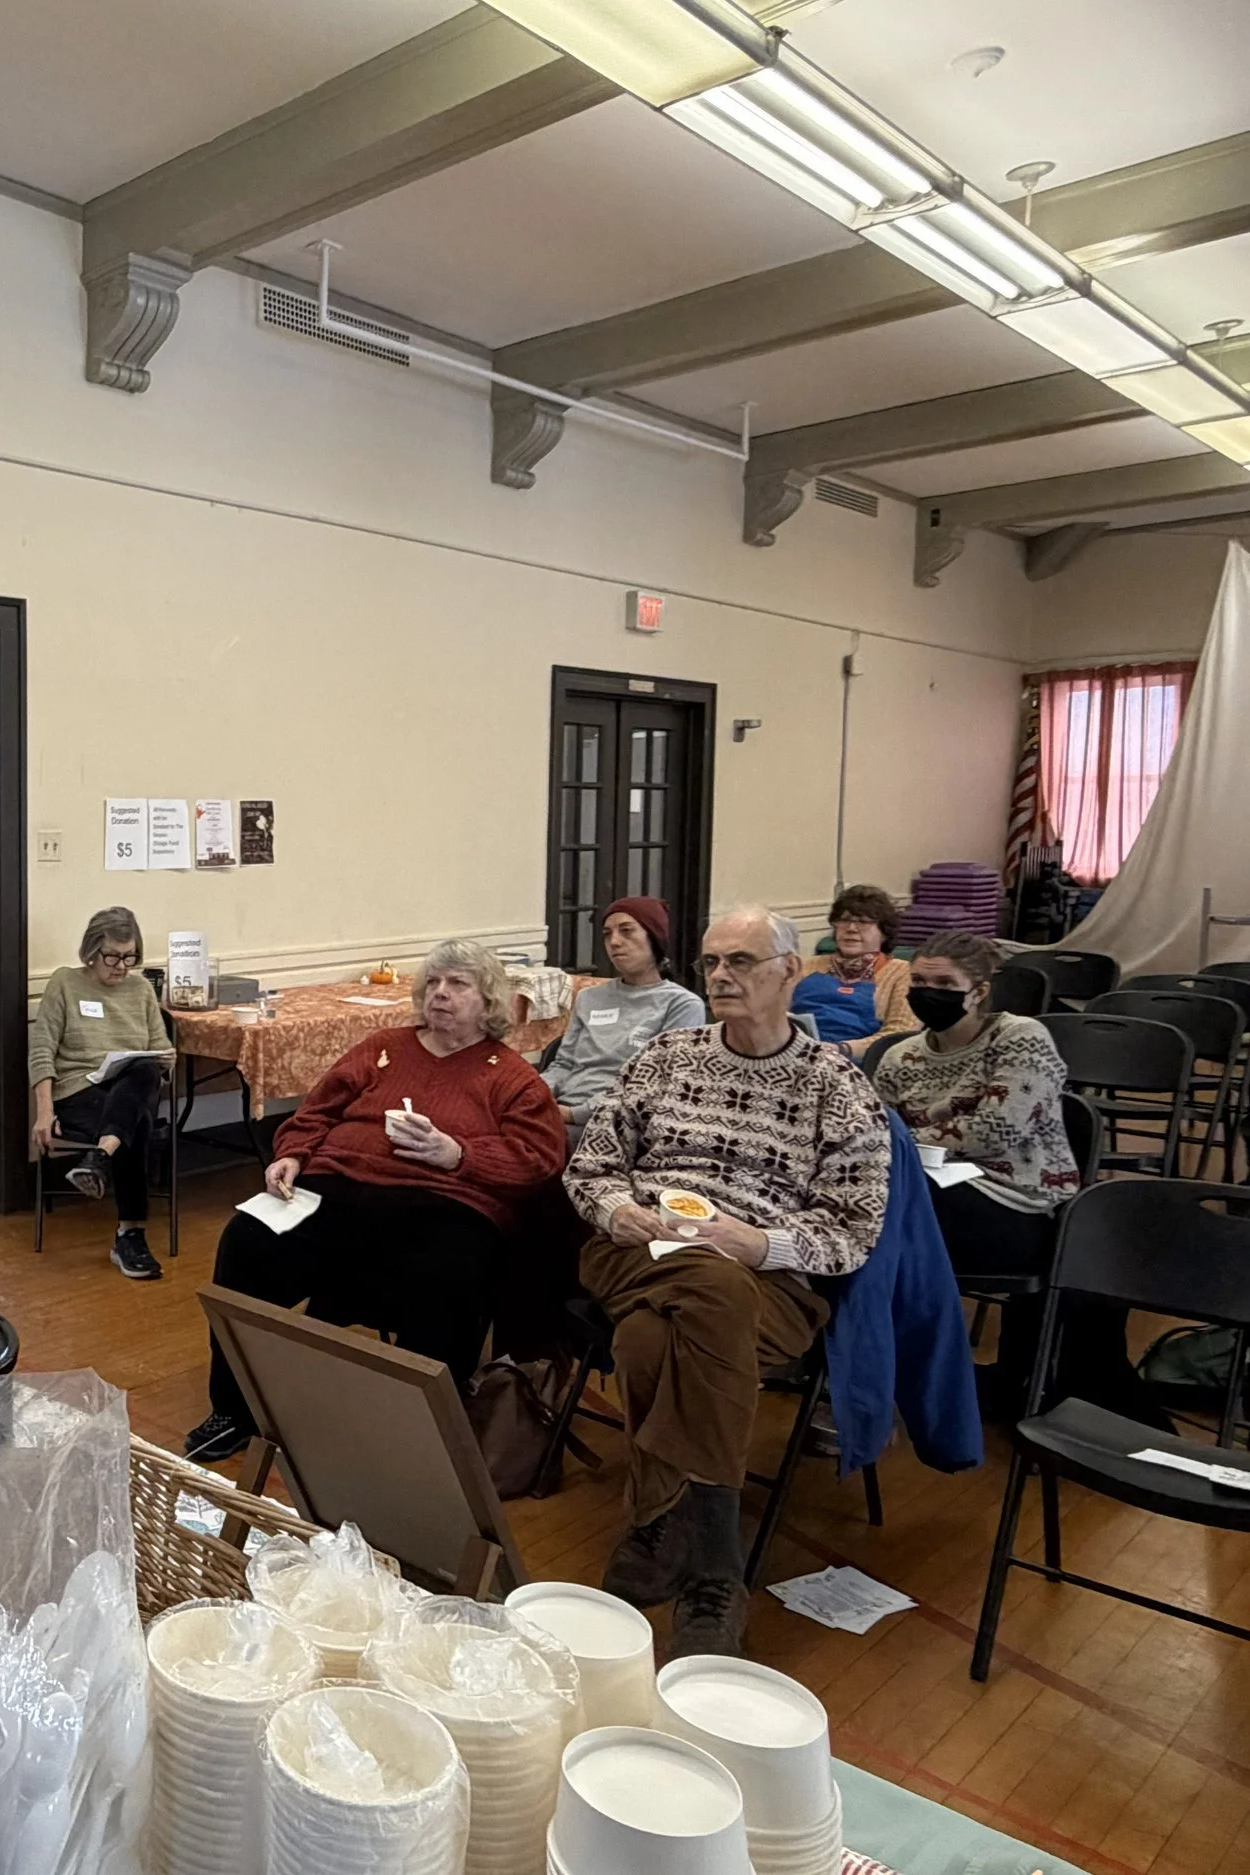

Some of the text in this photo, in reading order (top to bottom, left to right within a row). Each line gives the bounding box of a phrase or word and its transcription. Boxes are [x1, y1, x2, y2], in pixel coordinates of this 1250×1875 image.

[110, 806, 140, 815] Suggested
[111, 817, 139, 825] Donation
[117, 842, 132, 857] $5
